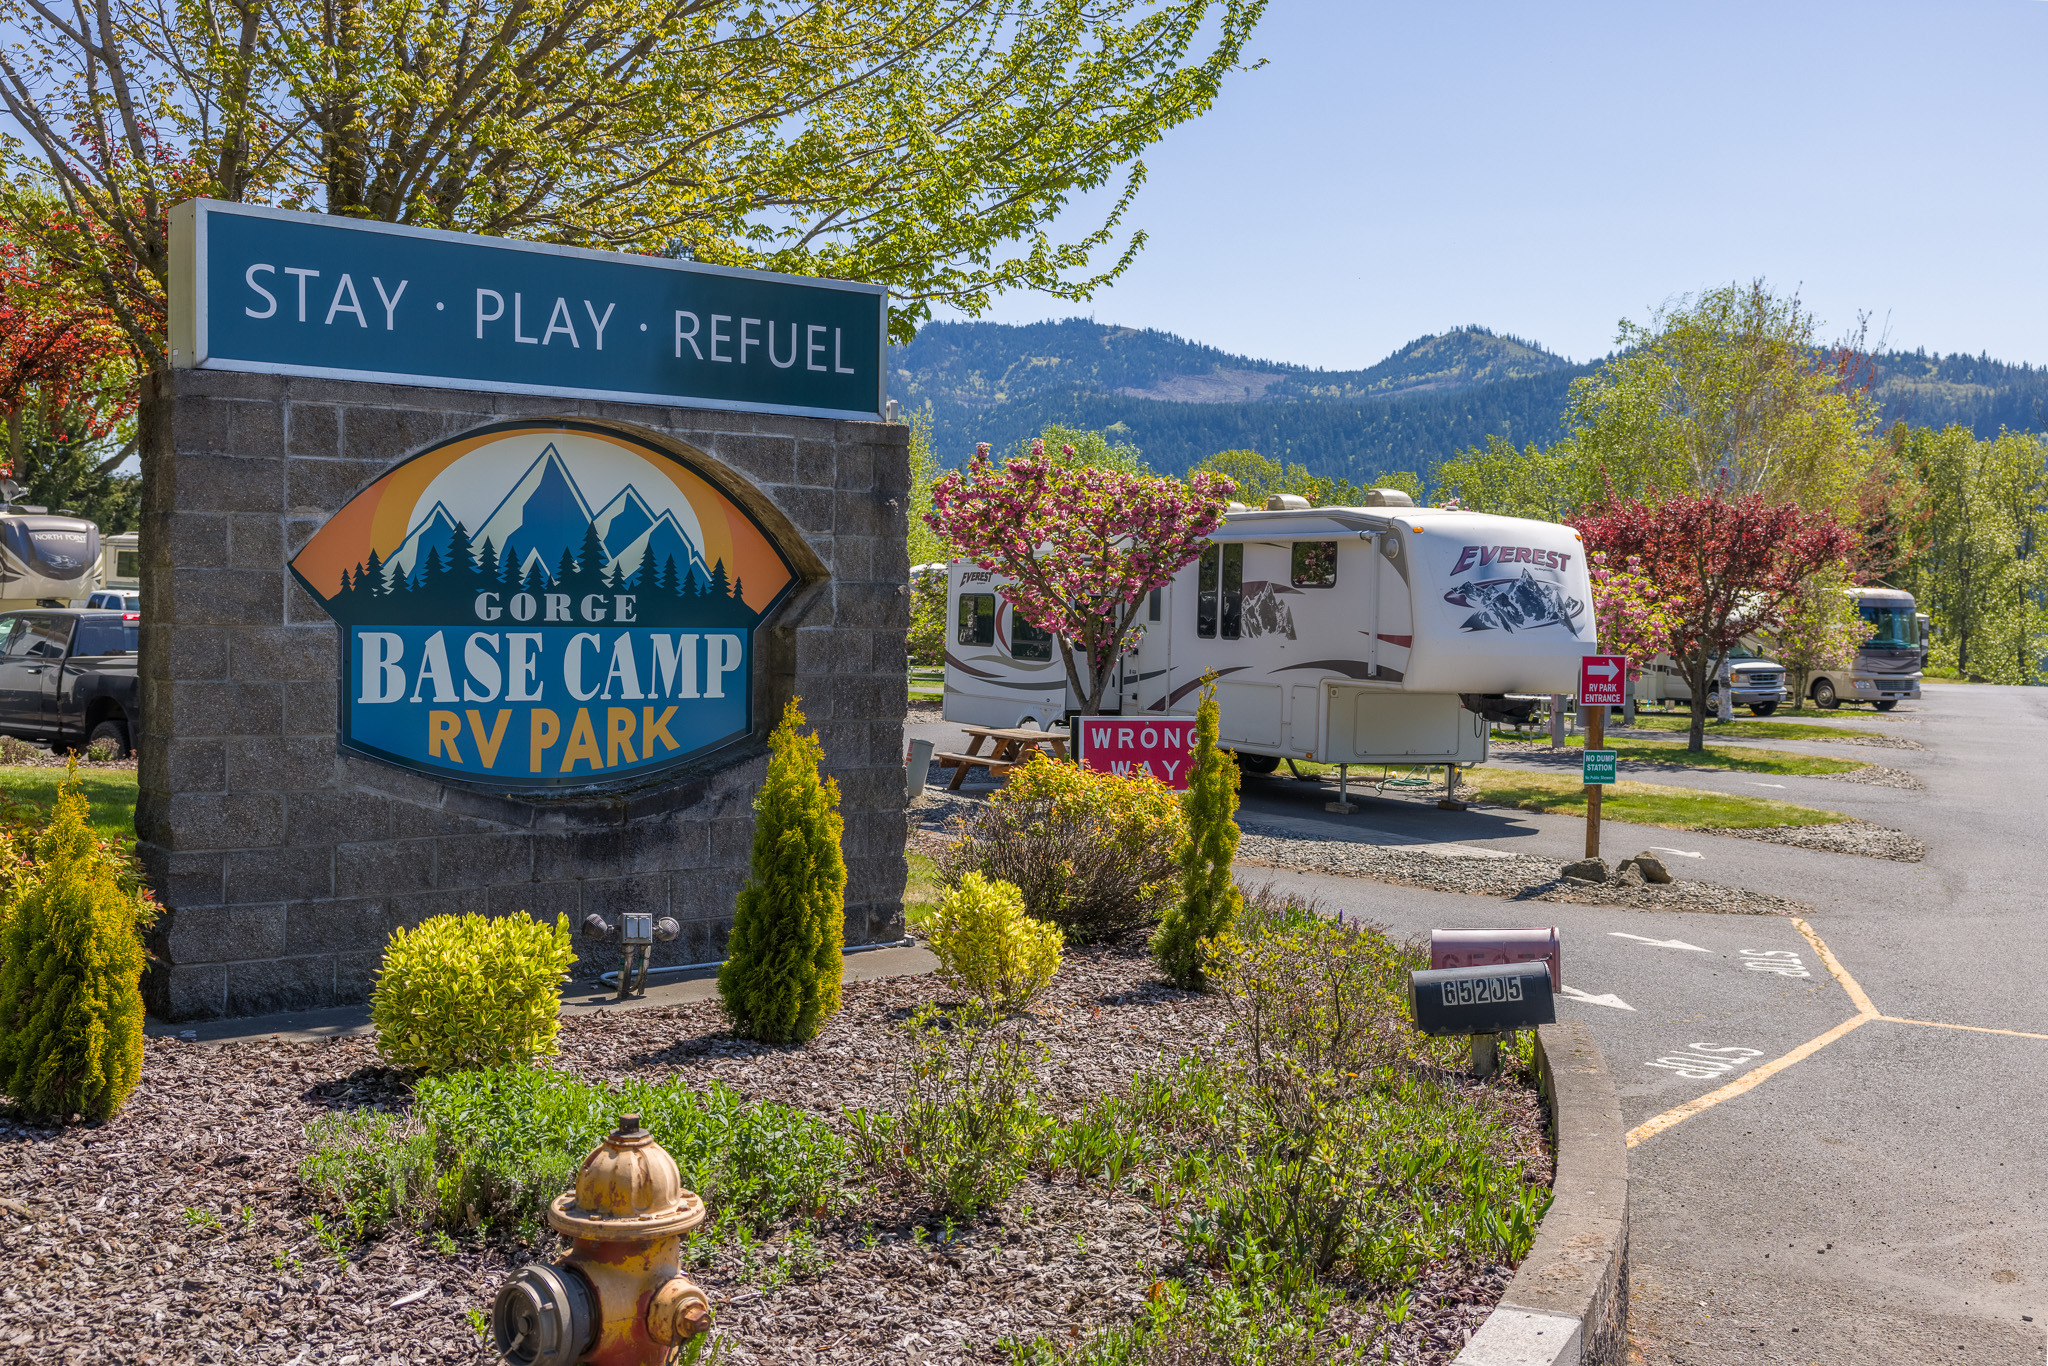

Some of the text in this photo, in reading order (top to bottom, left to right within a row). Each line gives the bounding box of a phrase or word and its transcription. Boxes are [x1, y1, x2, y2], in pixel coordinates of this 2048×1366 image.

[244, 263, 855, 375] STAY PLAY REFUEL
[1450, 546, 1571, 576] EVEREST
[960, 572, 993, 587] EVEREST
[475, 592, 637, 622] GORGE
[358, 630, 742, 704] BASE CAMP
[1585, 694, 1621, 702] ENTRANCE
[1589, 683, 1617, 692] RV PARK
[428, 705, 680, 773] RV PARK
[1091, 727, 1200, 749] WRONG
[1585, 754, 1614, 763] NO DUMP
[1739, 949, 1810, 977] STOP
[1443, 976, 1521, 1005] 65205
[1644, 1042, 1764, 1079] STOP
